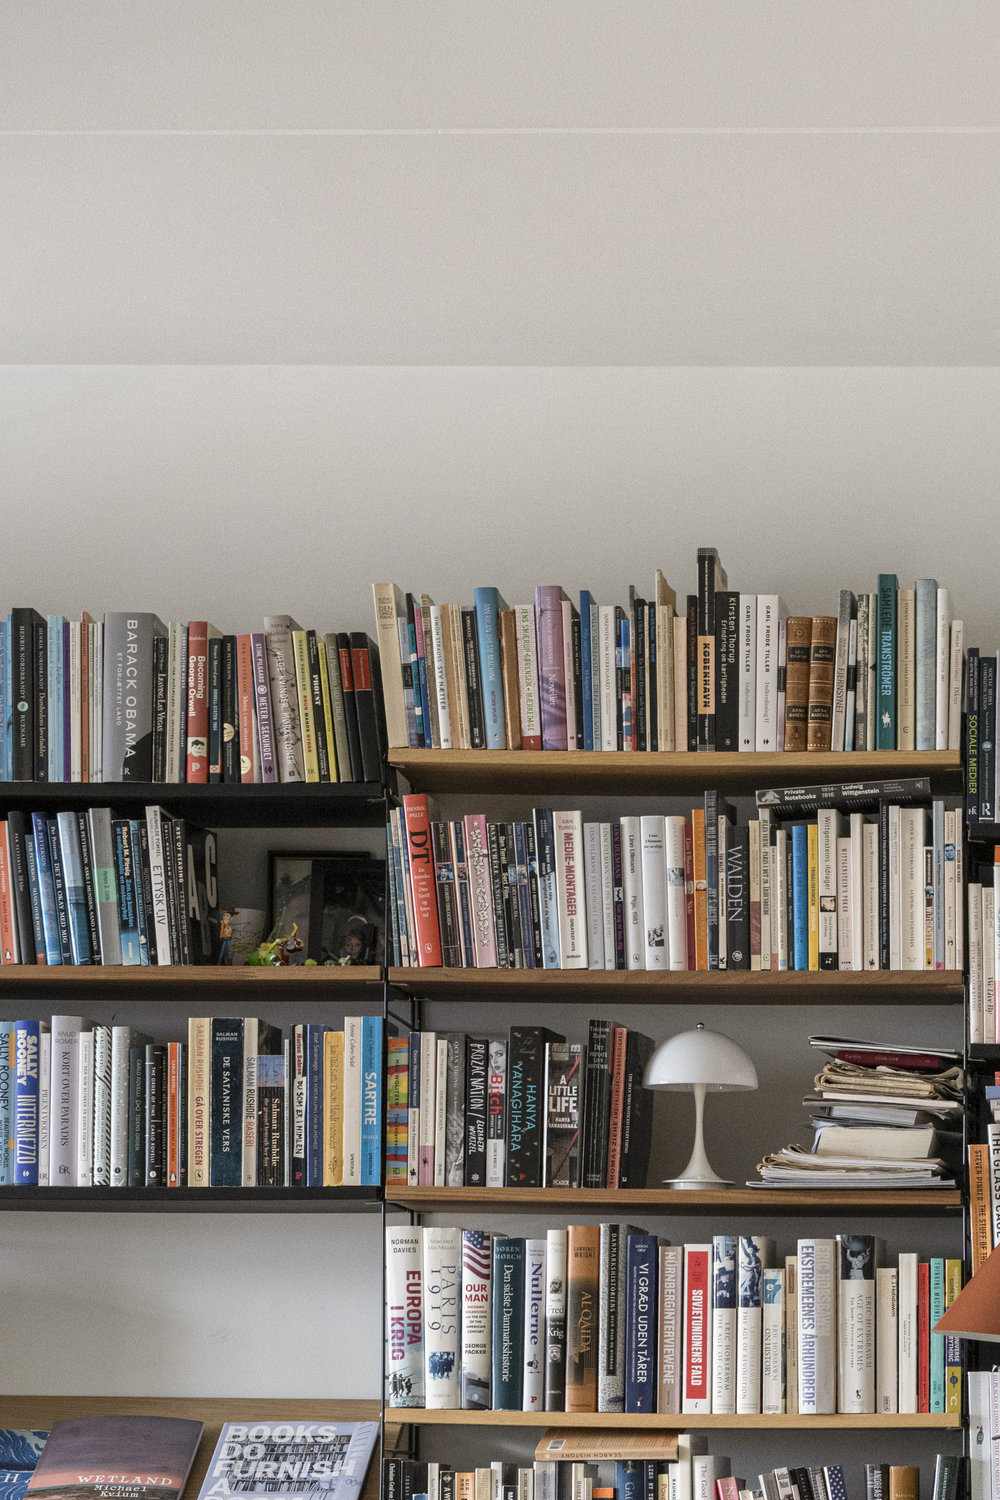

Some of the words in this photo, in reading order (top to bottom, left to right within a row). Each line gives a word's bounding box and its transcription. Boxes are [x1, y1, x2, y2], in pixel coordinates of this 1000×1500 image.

[728, 598, 736, 632] Kirsten
[881, 588, 891, 628] SAMLEDE
[127, 619, 138, 689] BARACK
[728, 633, 736, 665] Thorup
[881, 630, 894, 696] TRANSTRÖMER
[189, 655, 197, 689] George
[197, 655, 205, 698] Becoming
[702, 642, 712, 708] KØBENHAVN
[188, 690, 197, 717] Orwell
[125, 696, 138, 758] OBAMA
[969, 714, 978, 755] SOCIALE
[842, 788, 879, 796] Wittgenstein
[968, 759, 978, 794] MEDIER
[409, 831, 430, 864] DT
[564, 833, 576, 917] MEDIE-MONTAGER
[727, 845, 743, 922] WALDEN
[17, 1030, 28, 1086] ROONEY
[27, 1036, 38, 1078] SALLY
[222, 1056, 230, 1068] DE
[222, 1071, 231, 1125] SATANISKE
[364, 1072, 377, 1125] SARTRE
[490, 1074, 503, 1114] Bitch
[549, 1086, 577, 1096] LITTLE
[559, 1075, 567, 1085] A
[510, 1063, 523, 1151] YANAGIHARA
[526, 1085, 536, 1130] HANYA
[549, 1098, 577, 1112] LIFE
[17, 1095, 36, 1165] INTERMEZZO
[221, 1127, 230, 1153] VERS
[406, 1270, 422, 1345] EUROPA
[428, 1269, 441, 1331] 1919
[442, 1265, 456, 1334] PARIS
[464, 1294, 488, 1302] MAN
[466, 1284, 487, 1292] OUR
[530, 1262, 543, 1346] Nullerne
[801, 1245, 814, 1330] EKSTREMERNES
[391, 1317, 405, 1361] KRIG
[662, 1252, 675, 1385] NÜRNBERGINTERVIEWENE
[691, 1289, 702, 1365] SOVJETUNIONENS
[691, 1366, 702, 1386] FALD
[802, 1332, 818, 1406] ÅRHUNDREDE
[219, 1443, 266, 1459] DO
[225, 1425, 337, 1443] BOOKS
[78, 1475, 173, 1486] WETLAND
[207, 1480, 232, 1495] A
[213, 1459, 356, 1478] FURNISH
